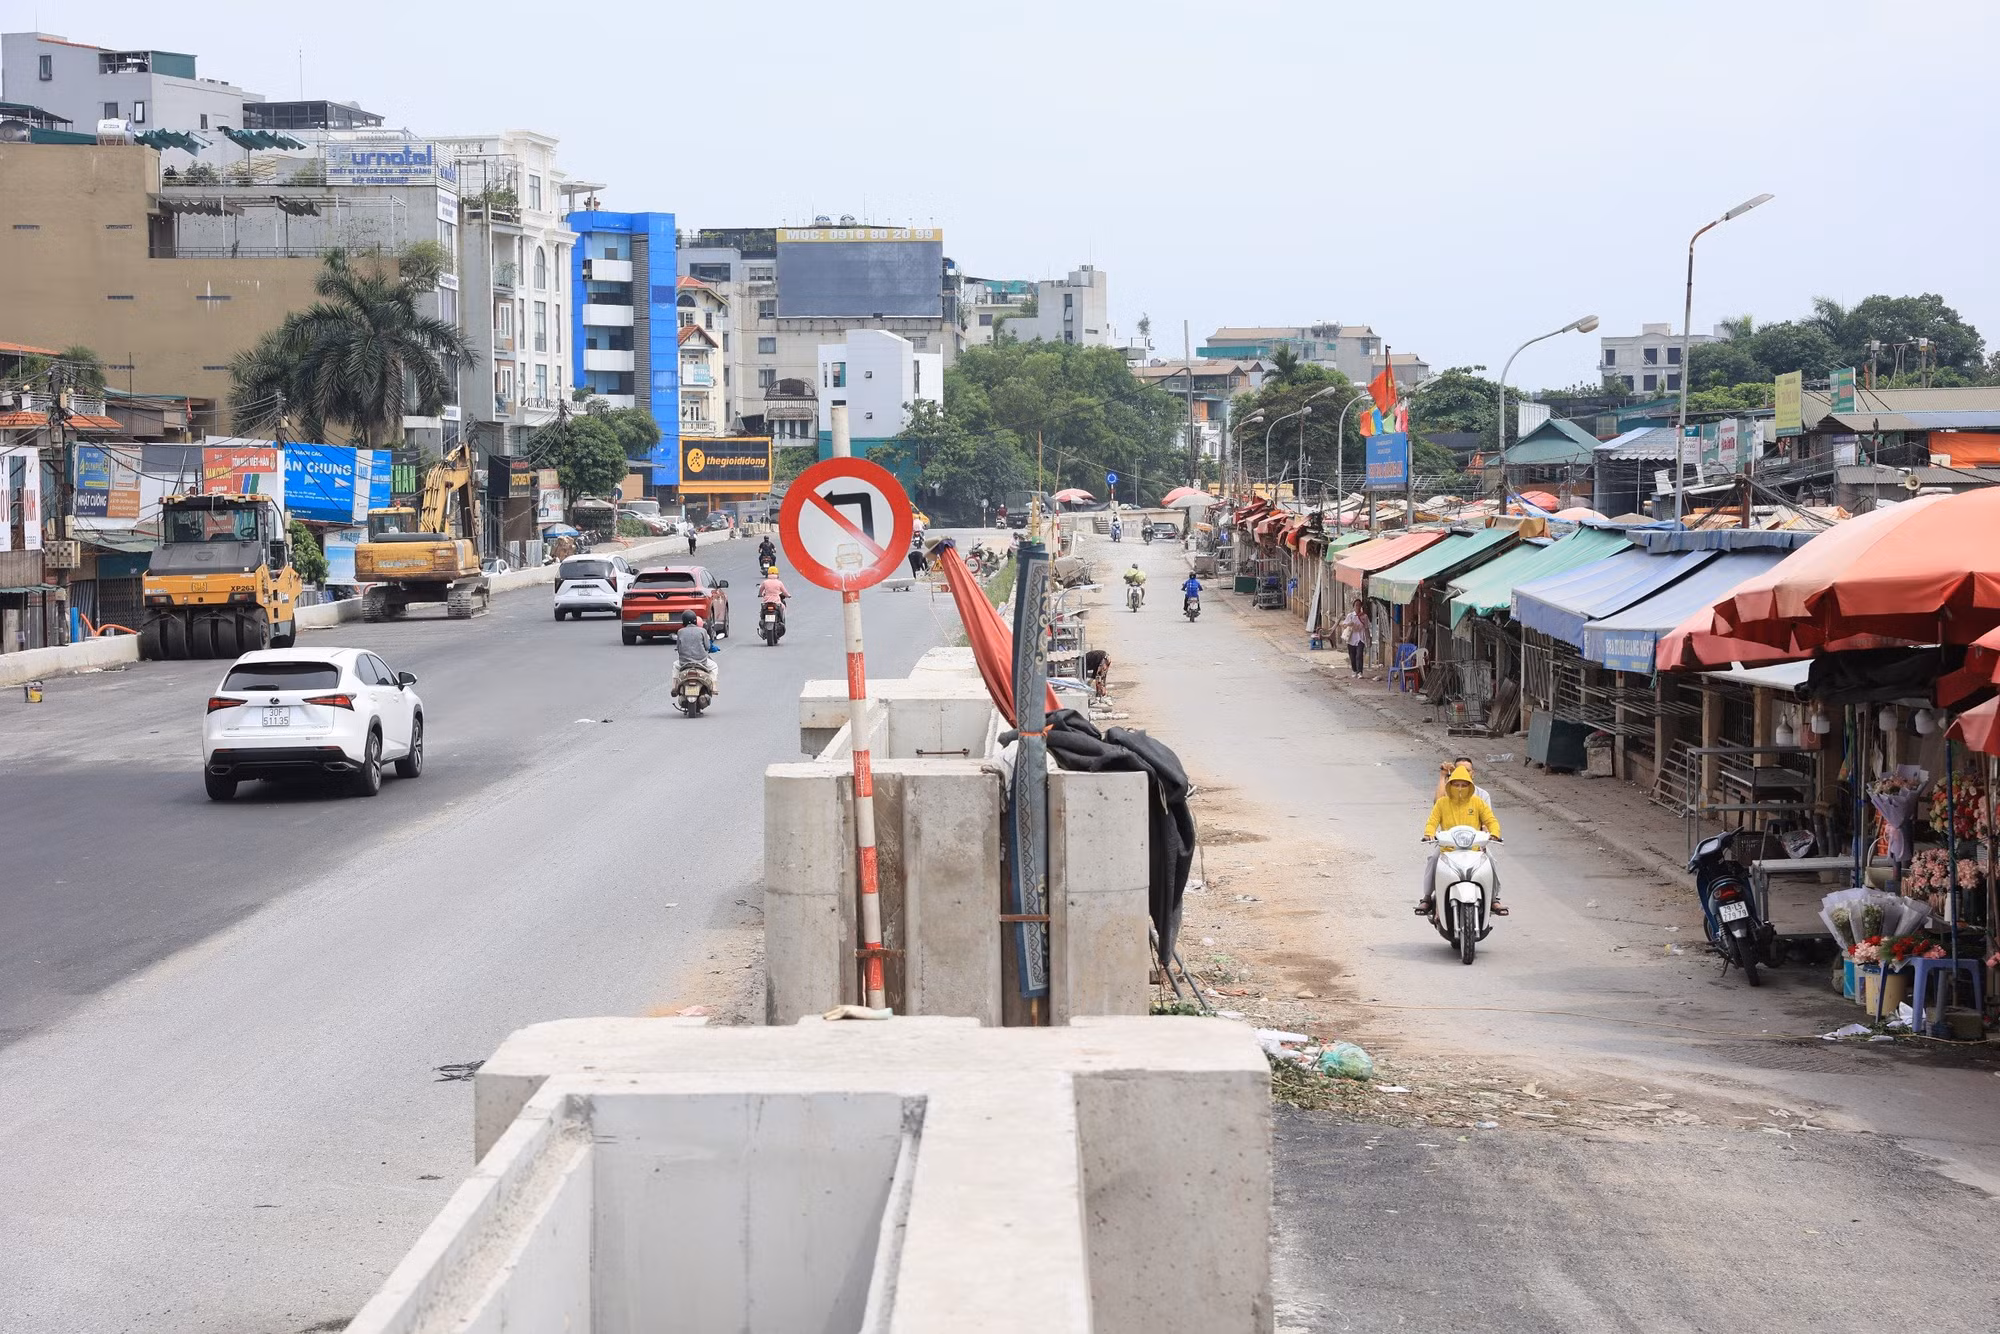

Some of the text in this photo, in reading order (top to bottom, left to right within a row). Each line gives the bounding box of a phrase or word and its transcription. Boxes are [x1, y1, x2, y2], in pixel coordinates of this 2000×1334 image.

[829, 229, 865, 240] 0916
[869, 229, 888, 240] 80
[892, 229, 911, 240] 20
[915, 229, 934, 240] 99
[706, 456, 767, 468] thegioididong
[306, 461, 352, 476] CHUNG
[77, 492, 90, 509] NHẬT
[91, 492, 107, 507] CƯỜNG
[269, 708, 283, 717] 30F
